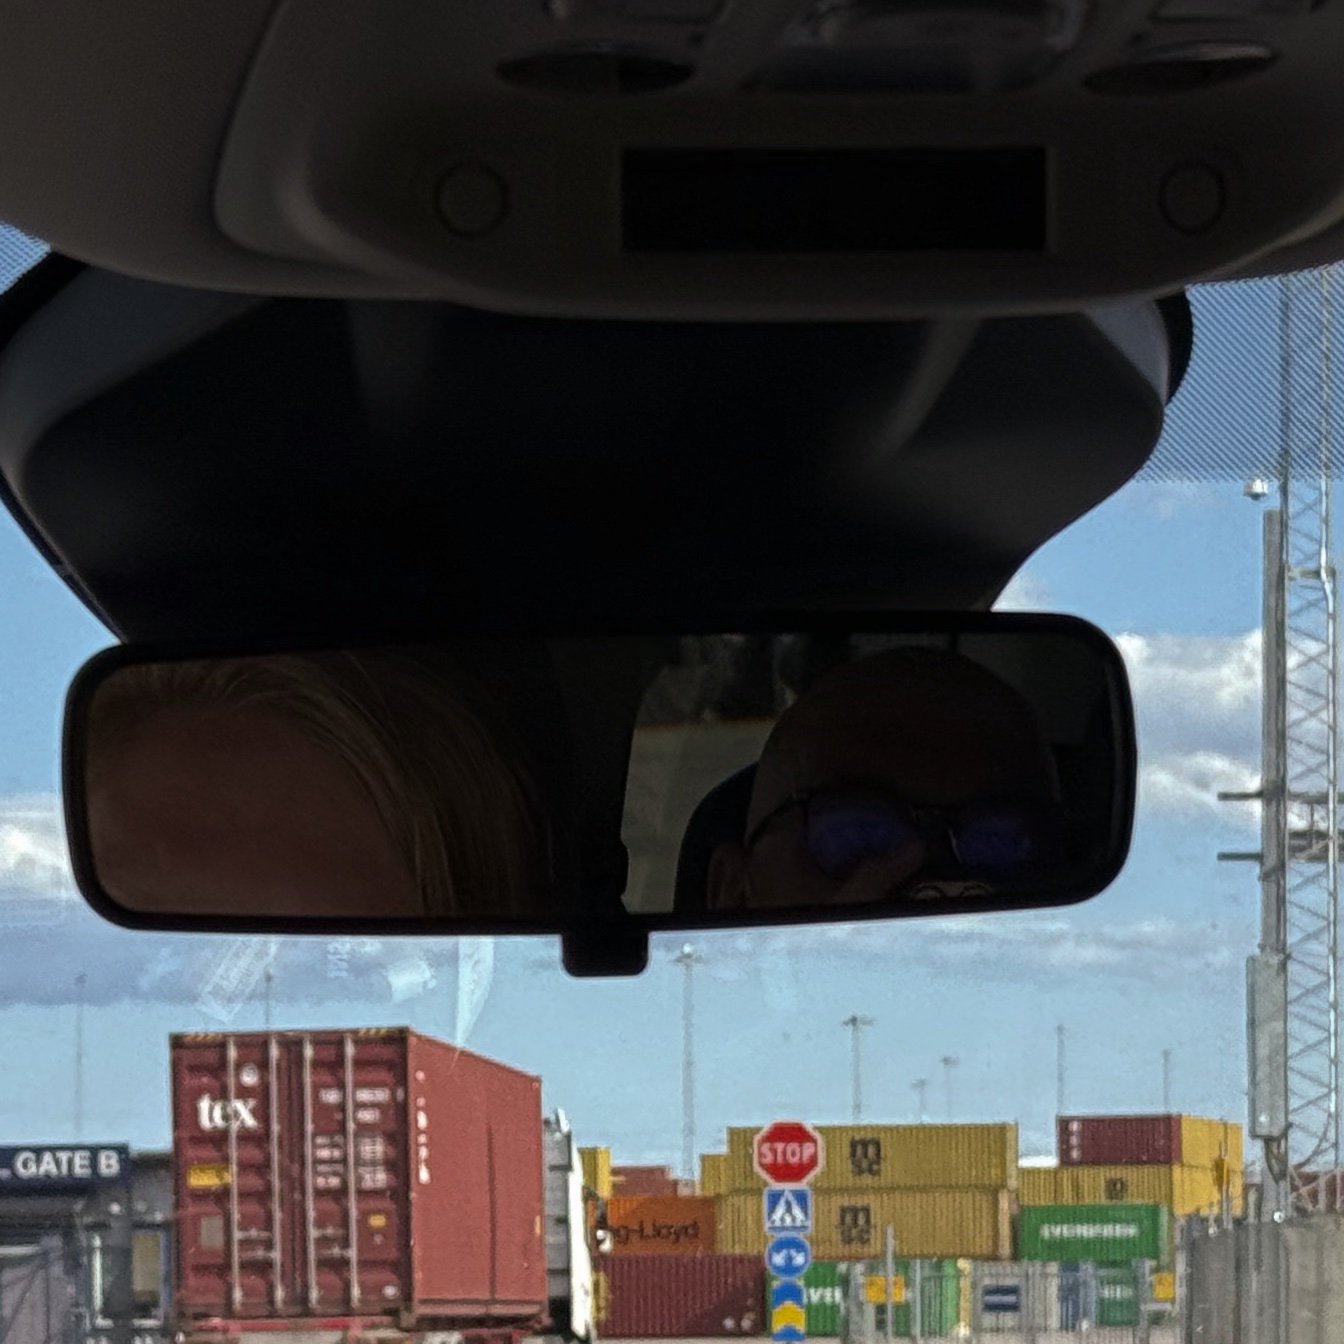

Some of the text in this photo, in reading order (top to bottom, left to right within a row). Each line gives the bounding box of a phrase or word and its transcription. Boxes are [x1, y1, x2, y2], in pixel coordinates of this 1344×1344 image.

[13, 1149, 93, 1180] GATE
[97, 1148, 121, 1178] B
[760, 1141, 816, 1166] STOP
